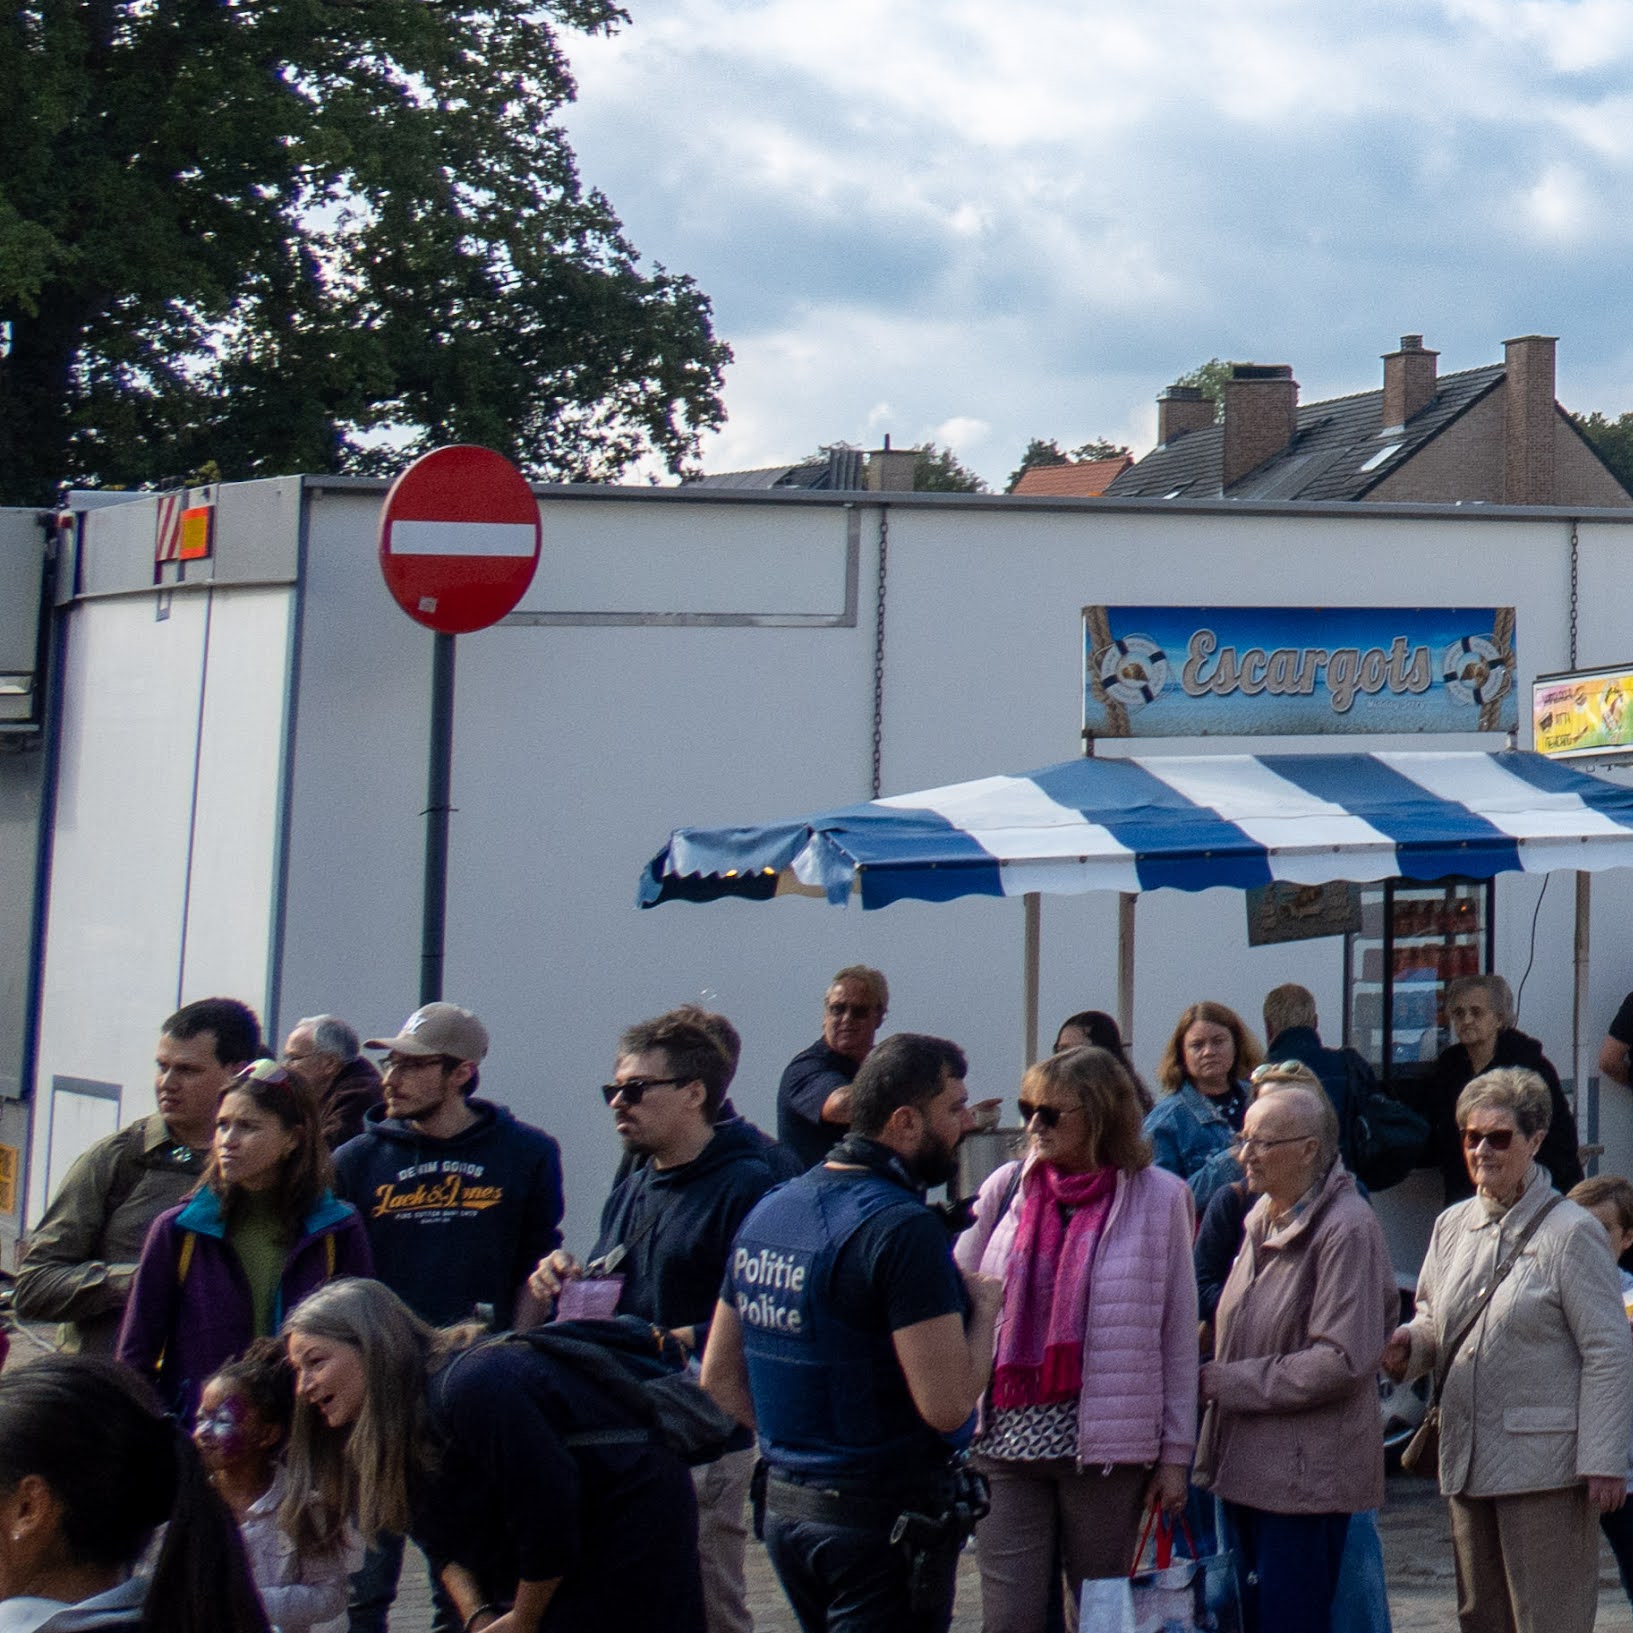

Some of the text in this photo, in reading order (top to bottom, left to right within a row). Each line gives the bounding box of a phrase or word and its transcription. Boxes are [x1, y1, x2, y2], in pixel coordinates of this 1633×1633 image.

[1182, 628, 1432, 713] Escargots
[733, 1247, 806, 1292] Politie
[736, 1290, 802, 1334] Police
